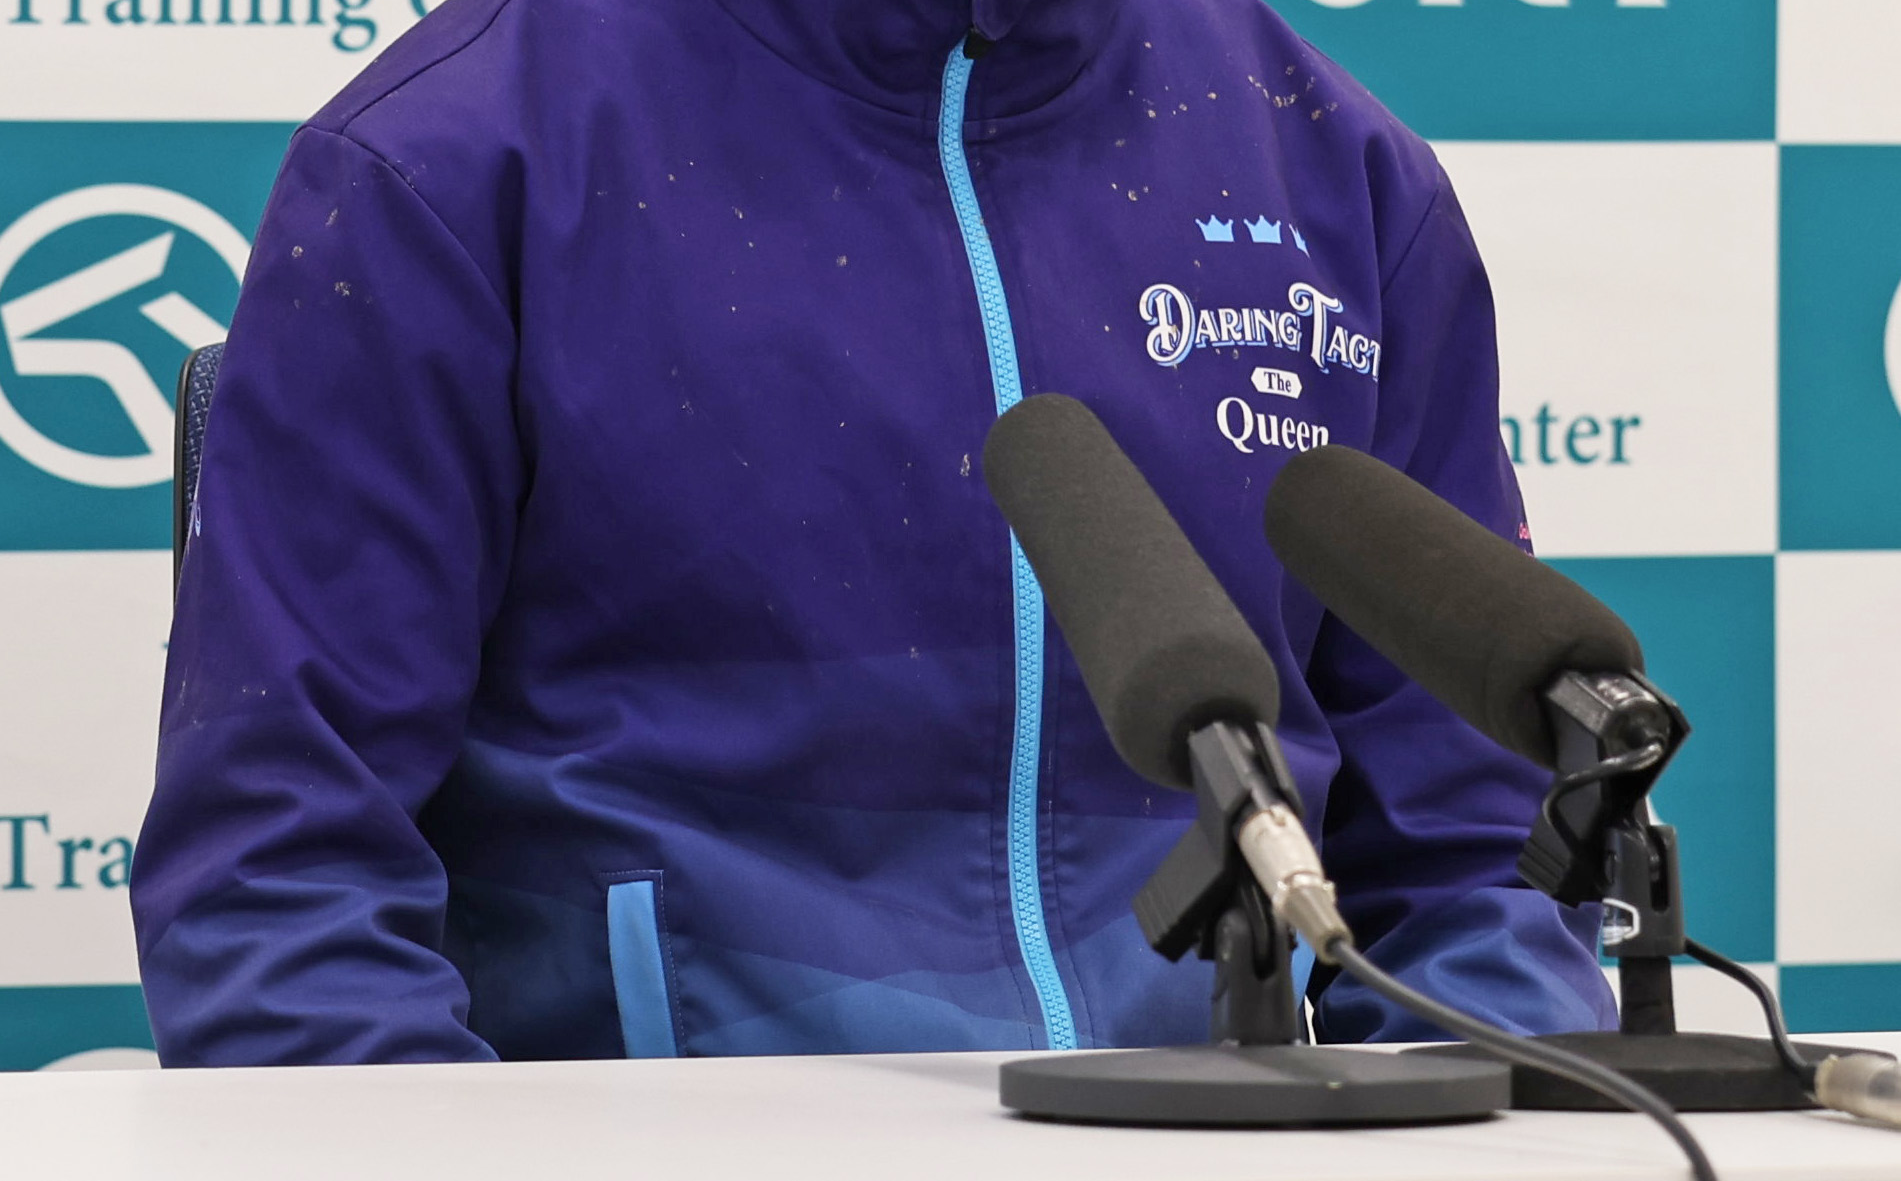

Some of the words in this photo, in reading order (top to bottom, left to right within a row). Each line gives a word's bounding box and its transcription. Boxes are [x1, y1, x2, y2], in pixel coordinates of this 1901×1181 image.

[1139, 284, 1302, 366] DARING
[1263, 371, 1292, 393] The
[1216, 397, 1330, 454] Queen
[1501, 402, 1643, 466] nter
